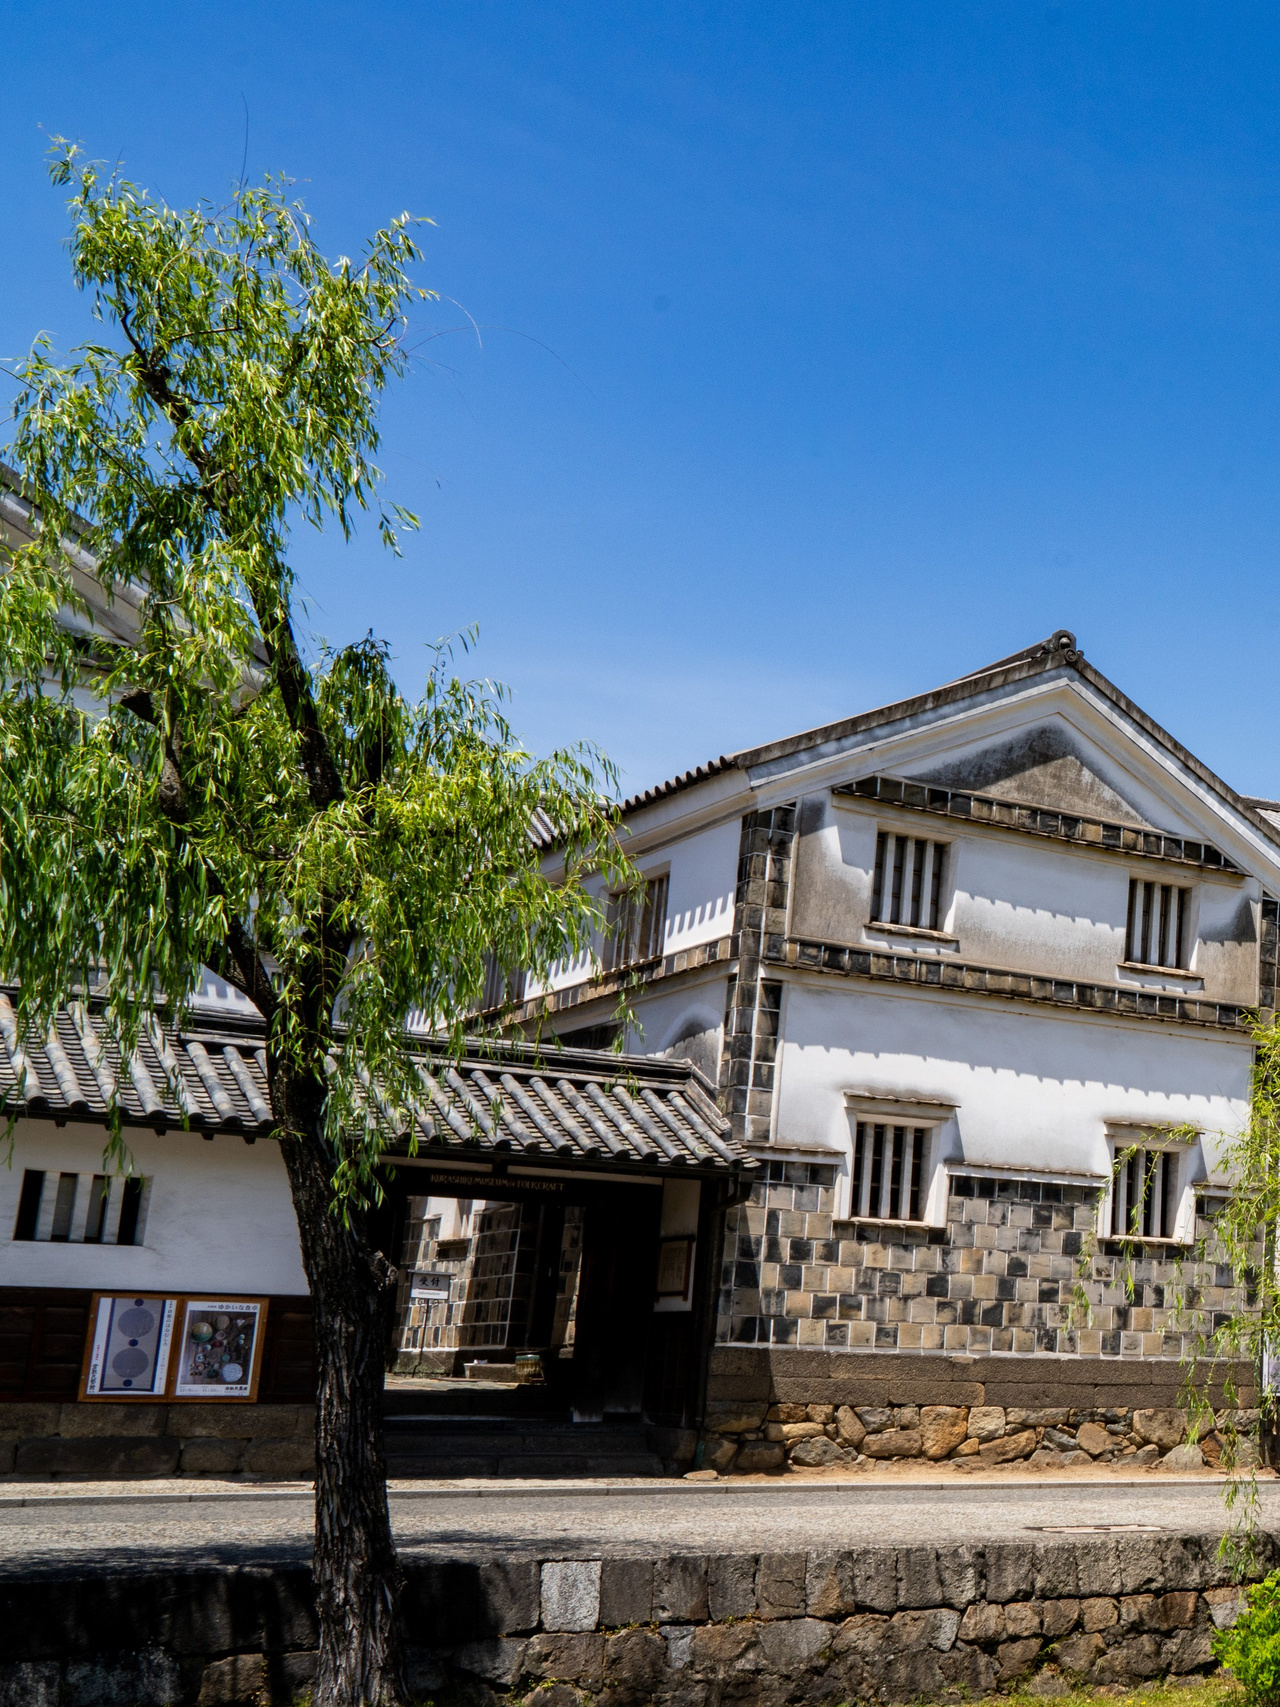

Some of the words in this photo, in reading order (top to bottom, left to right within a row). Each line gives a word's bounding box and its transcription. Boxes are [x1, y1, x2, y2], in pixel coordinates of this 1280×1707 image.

[430, 1174, 474, 1186] KURASHIKI
[474, 1177, 508, 1187] MUSEUM
[517, 1180, 566, 1191] FOLKCRAFT
[419, 1276, 440, 1287] 受付
